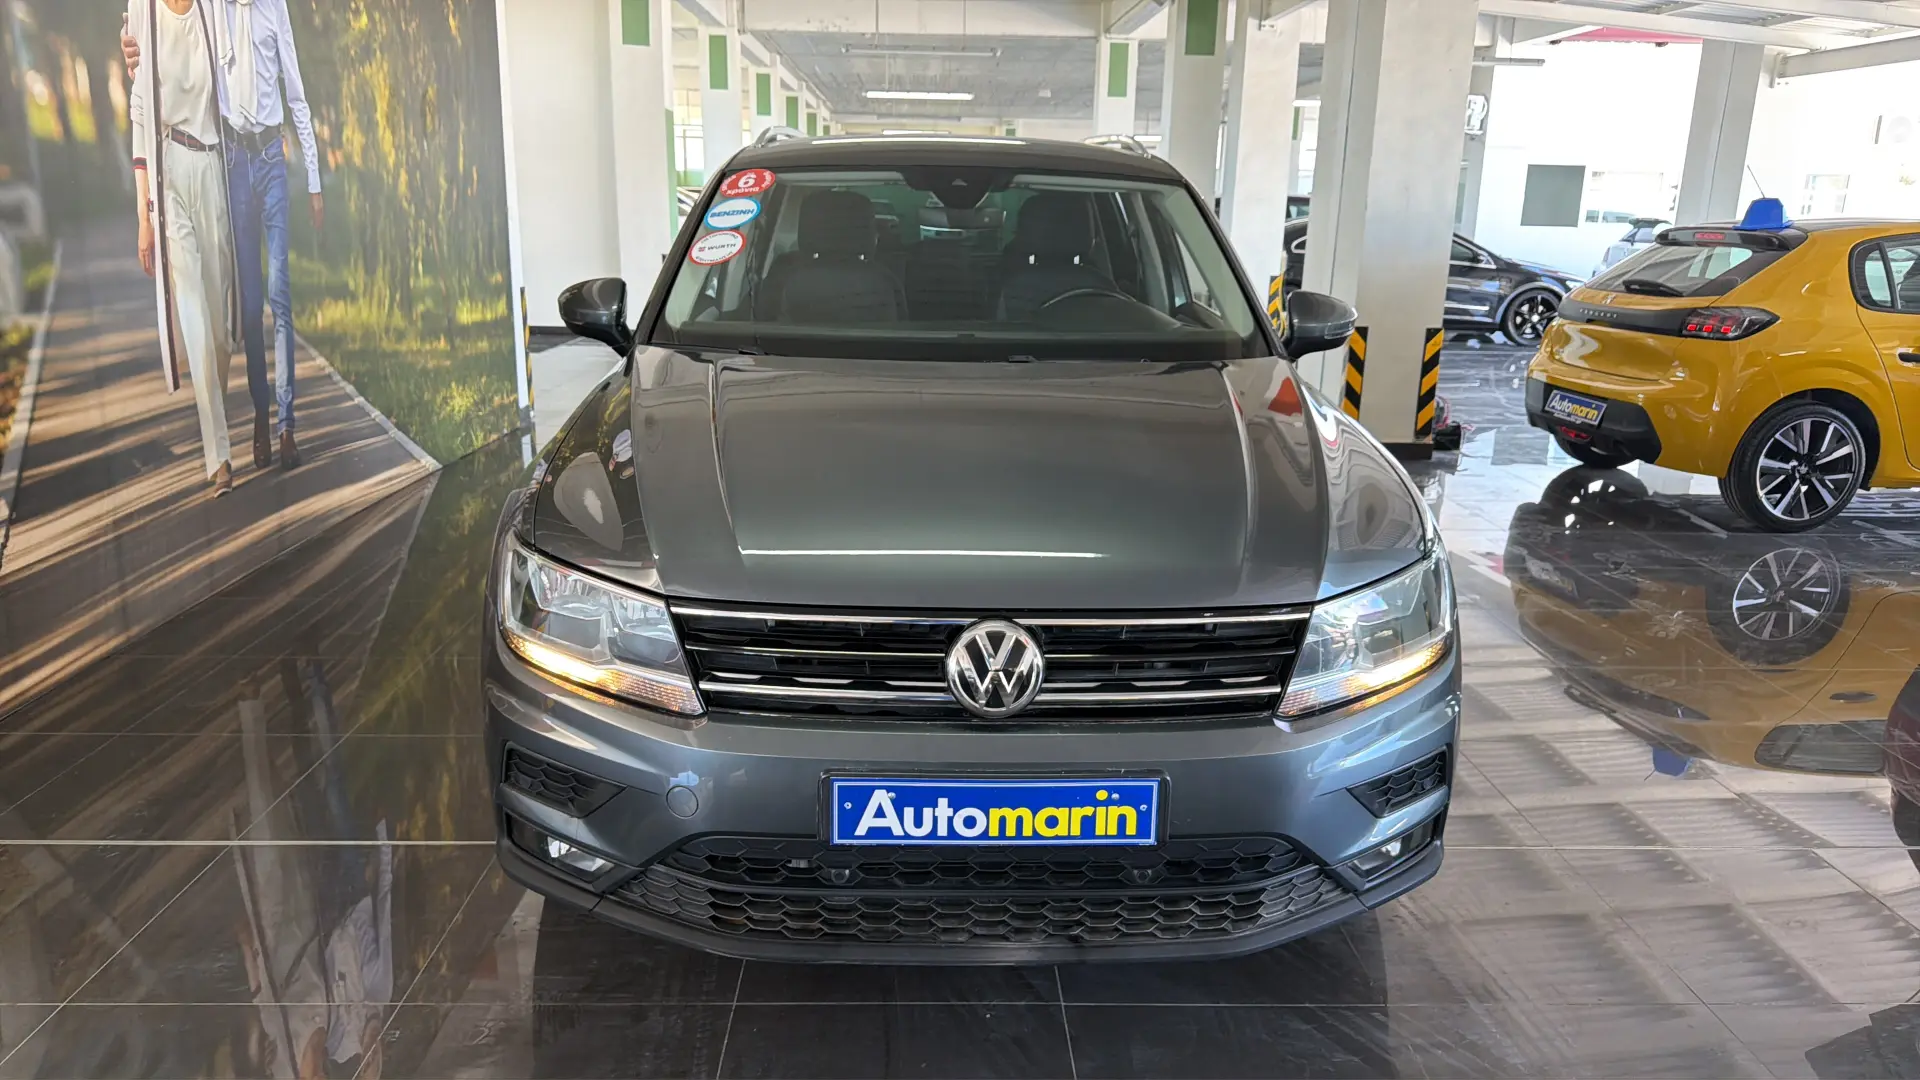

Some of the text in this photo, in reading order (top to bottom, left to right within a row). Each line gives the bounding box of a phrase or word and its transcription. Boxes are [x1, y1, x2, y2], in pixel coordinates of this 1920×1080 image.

[738, 174, 757, 188] 6
[1549, 394, 1598, 421] Automarin
[854, 788, 1138, 838] Automarin
